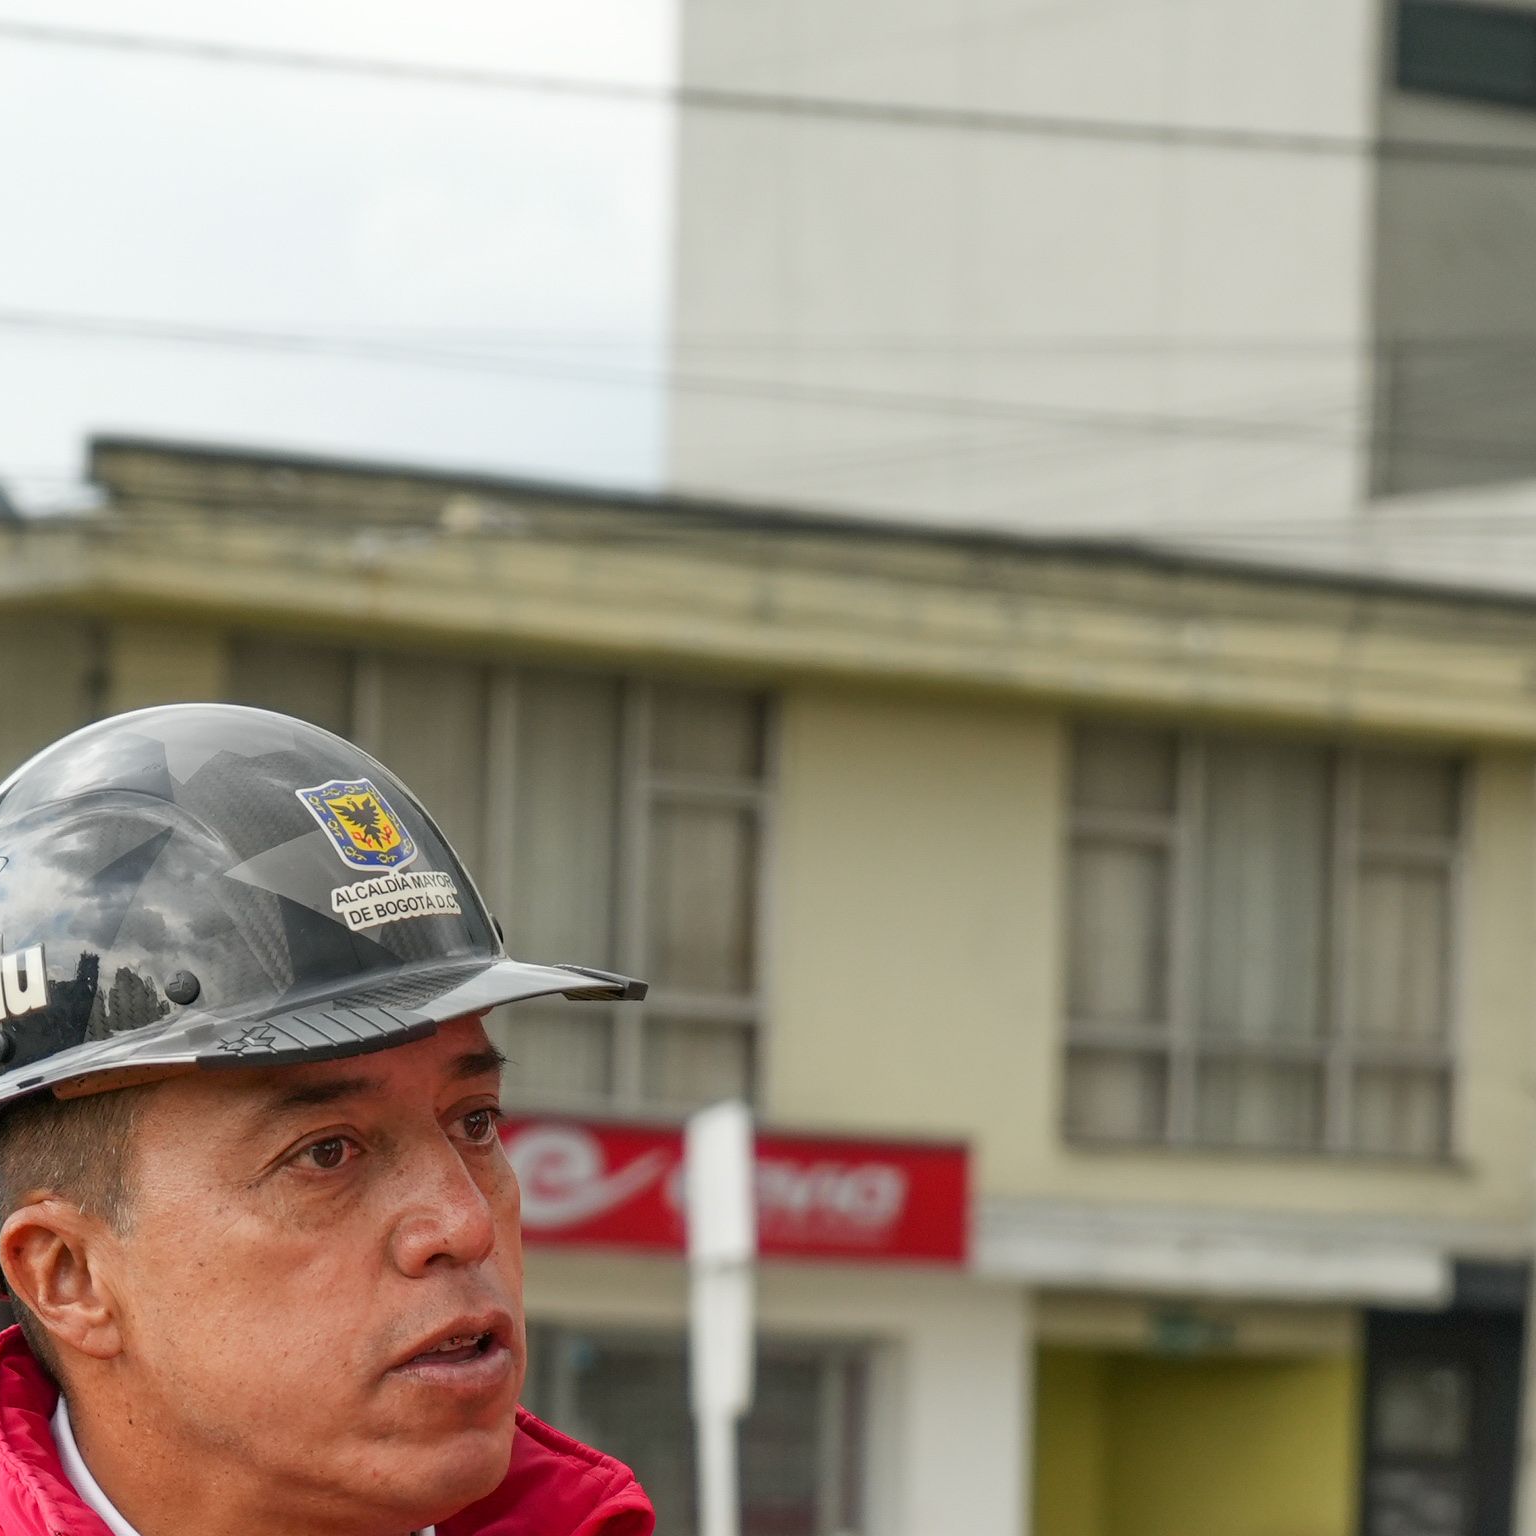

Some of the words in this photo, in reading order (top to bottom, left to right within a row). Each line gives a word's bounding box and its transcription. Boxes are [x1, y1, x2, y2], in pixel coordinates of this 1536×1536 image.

[335, 874, 412, 906] ALCALDÍA
[412, 874, 455, 890] MAYOR
[349, 906, 373, 925] DE
[374, 892, 434, 918] BOGOTÁ
